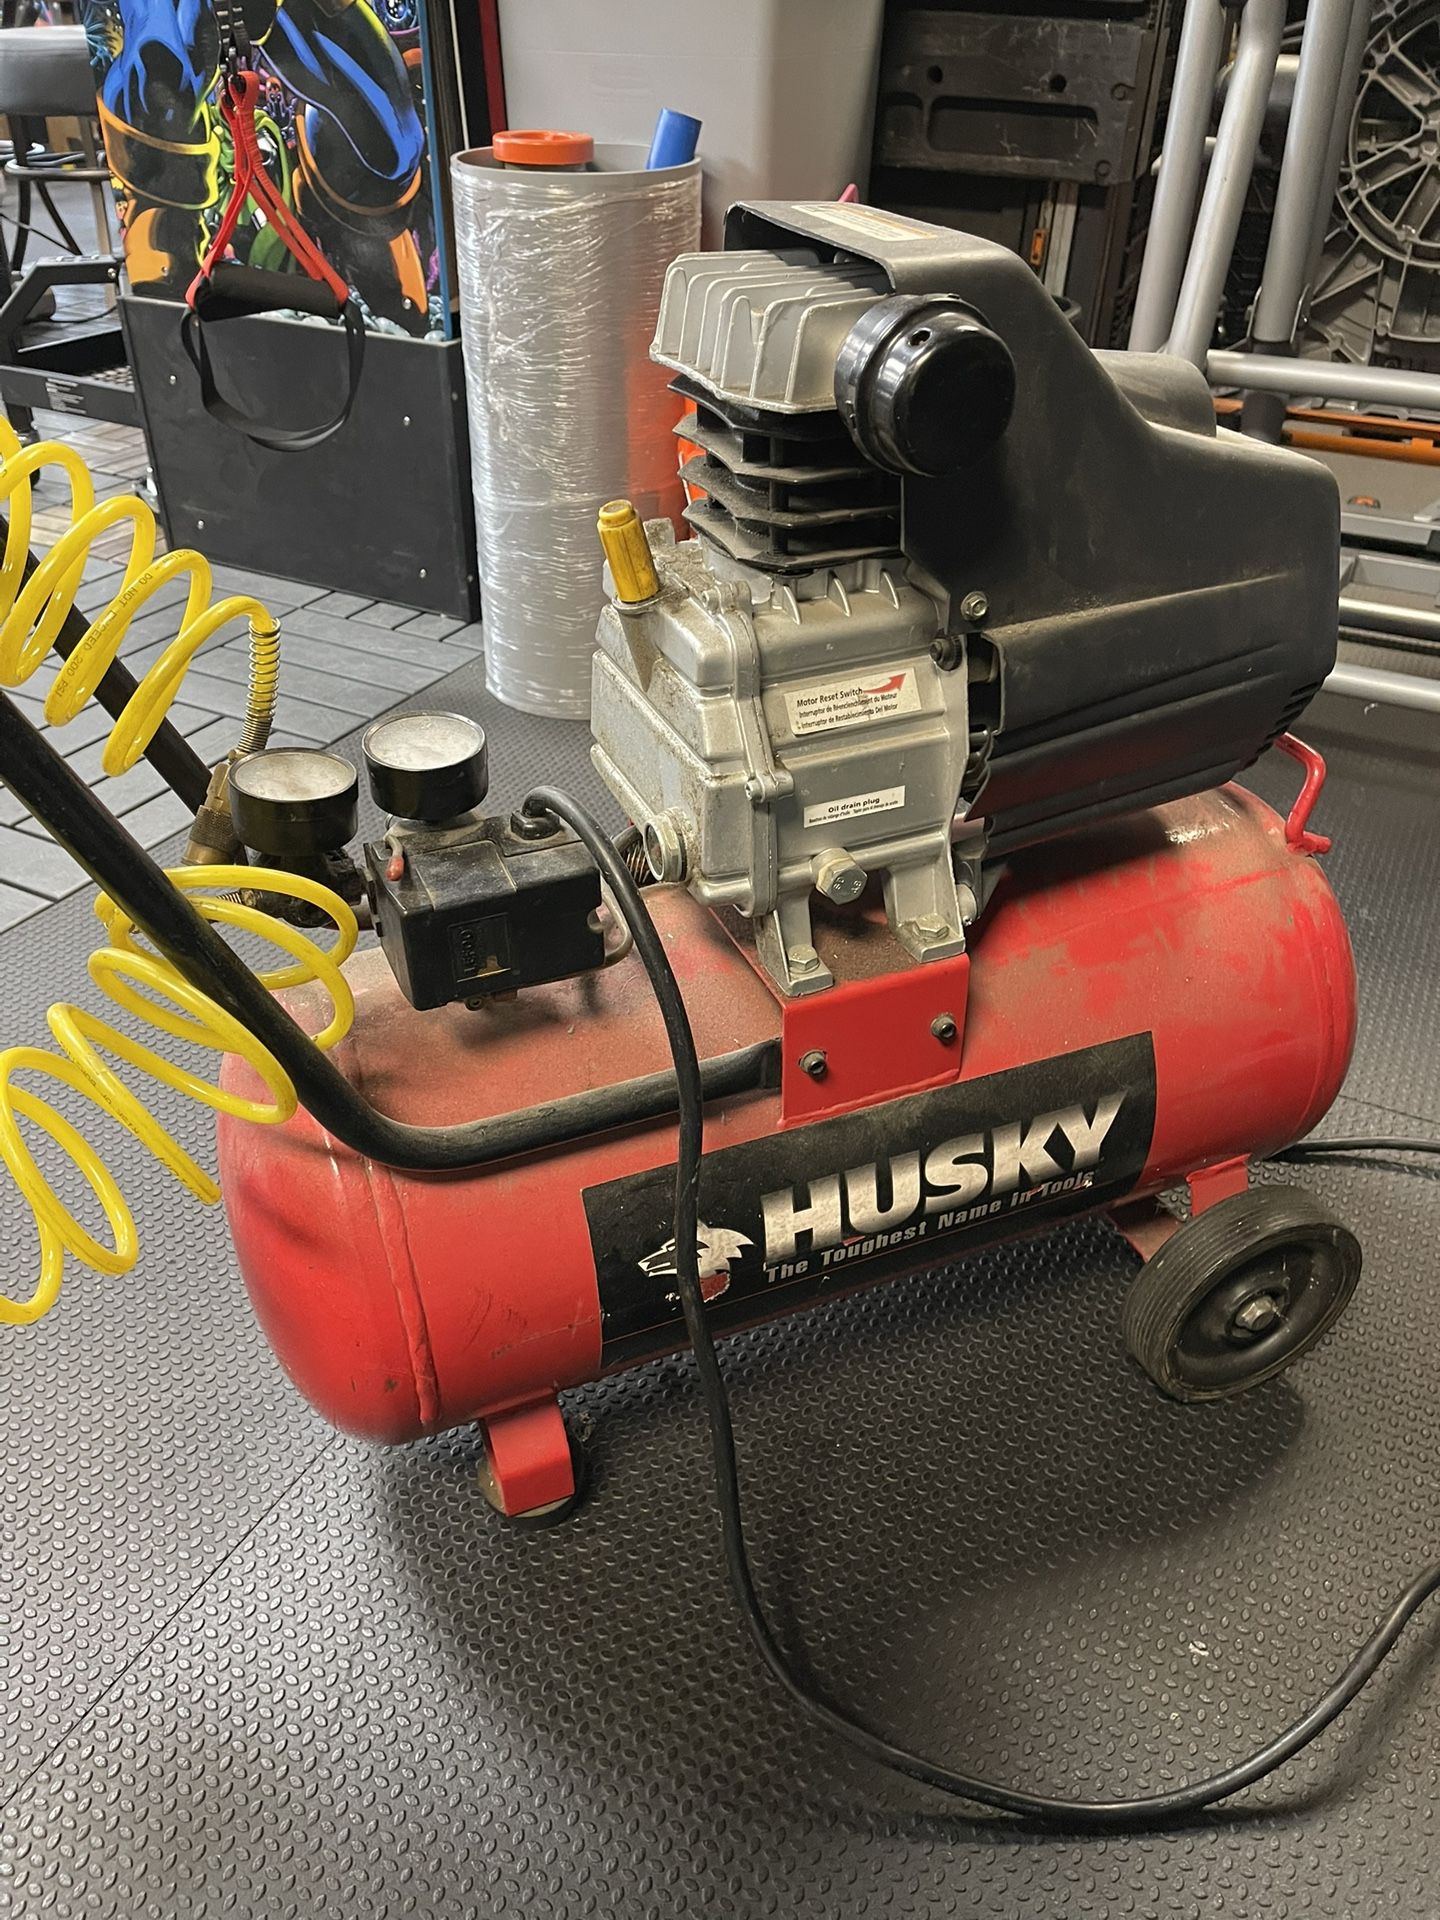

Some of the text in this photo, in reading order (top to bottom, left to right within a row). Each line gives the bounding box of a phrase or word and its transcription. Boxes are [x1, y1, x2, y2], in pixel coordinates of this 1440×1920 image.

[139, 572, 153, 585] DO
[119, 588, 138, 607] NOT
[66, 654, 83, 677] 200
[56, 680, 70, 697] PSI
[797, 687, 863, 708] Motor Reset Switch
[828, 805, 840, 814] Oil
[840, 801, 861, 811] drain
[862, 797, 880, 807] plug
[761, 1090, 1128, 1263] HUSKY
[766, 1170, 1095, 1283] The Toughest Name in Tools
